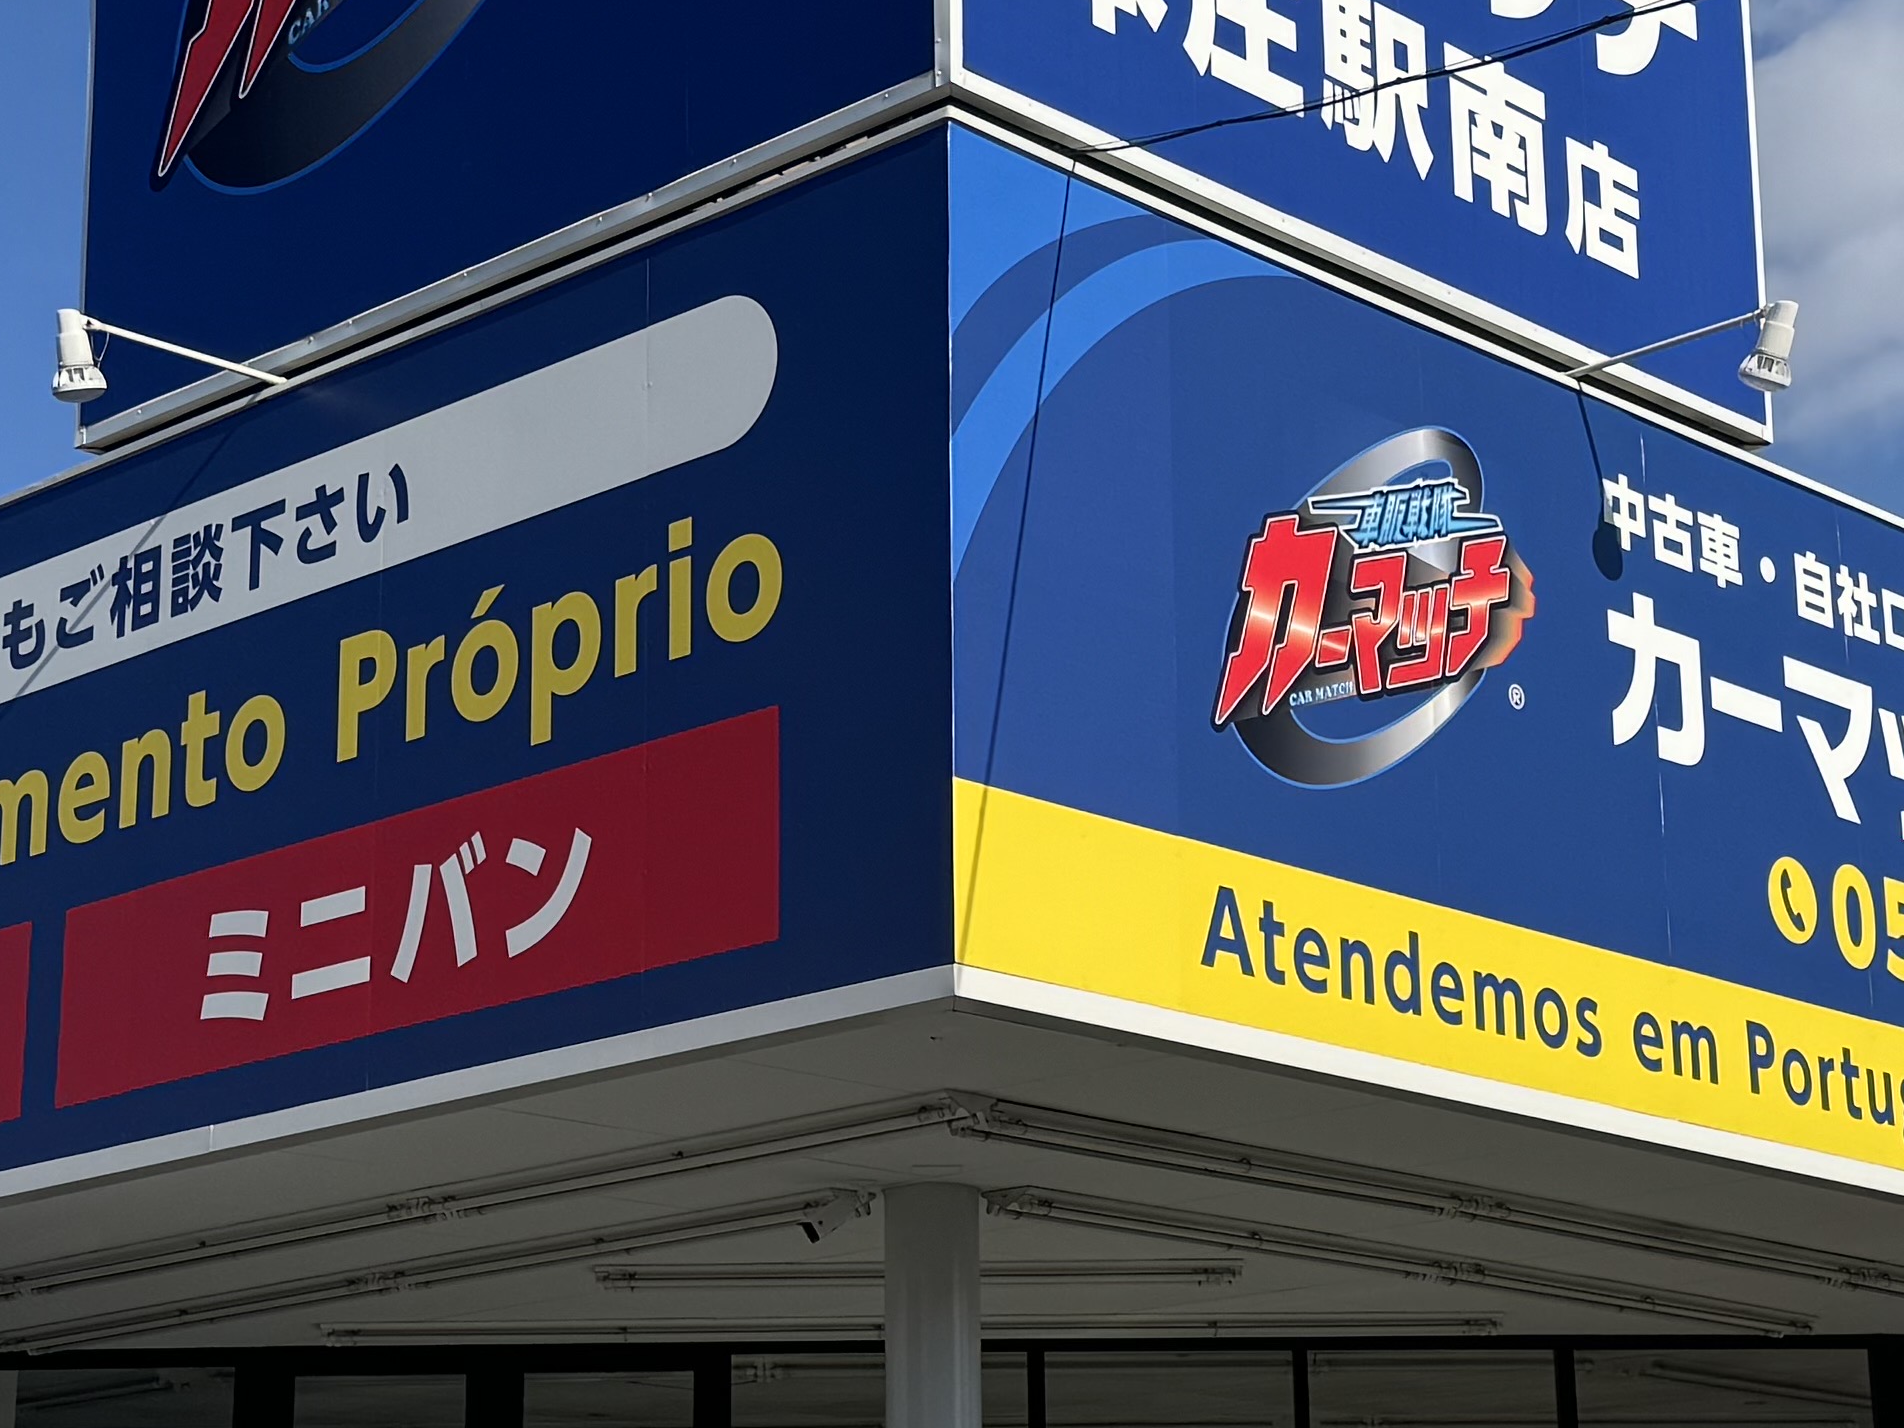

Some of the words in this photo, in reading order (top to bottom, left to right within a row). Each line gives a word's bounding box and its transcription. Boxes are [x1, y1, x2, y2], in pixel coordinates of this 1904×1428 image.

[335, 516, 785, 766] Próprio
[1215, 513, 1511, 725] カーマッチ
[1289, 689, 1313, 707] CAR
[1315, 681, 1356, 702] MATCH
[198, 824, 593, 1024] ミニバン
[1201, 884, 1601, 1060] Atendemos
[1634, 1010, 1720, 1086] em
